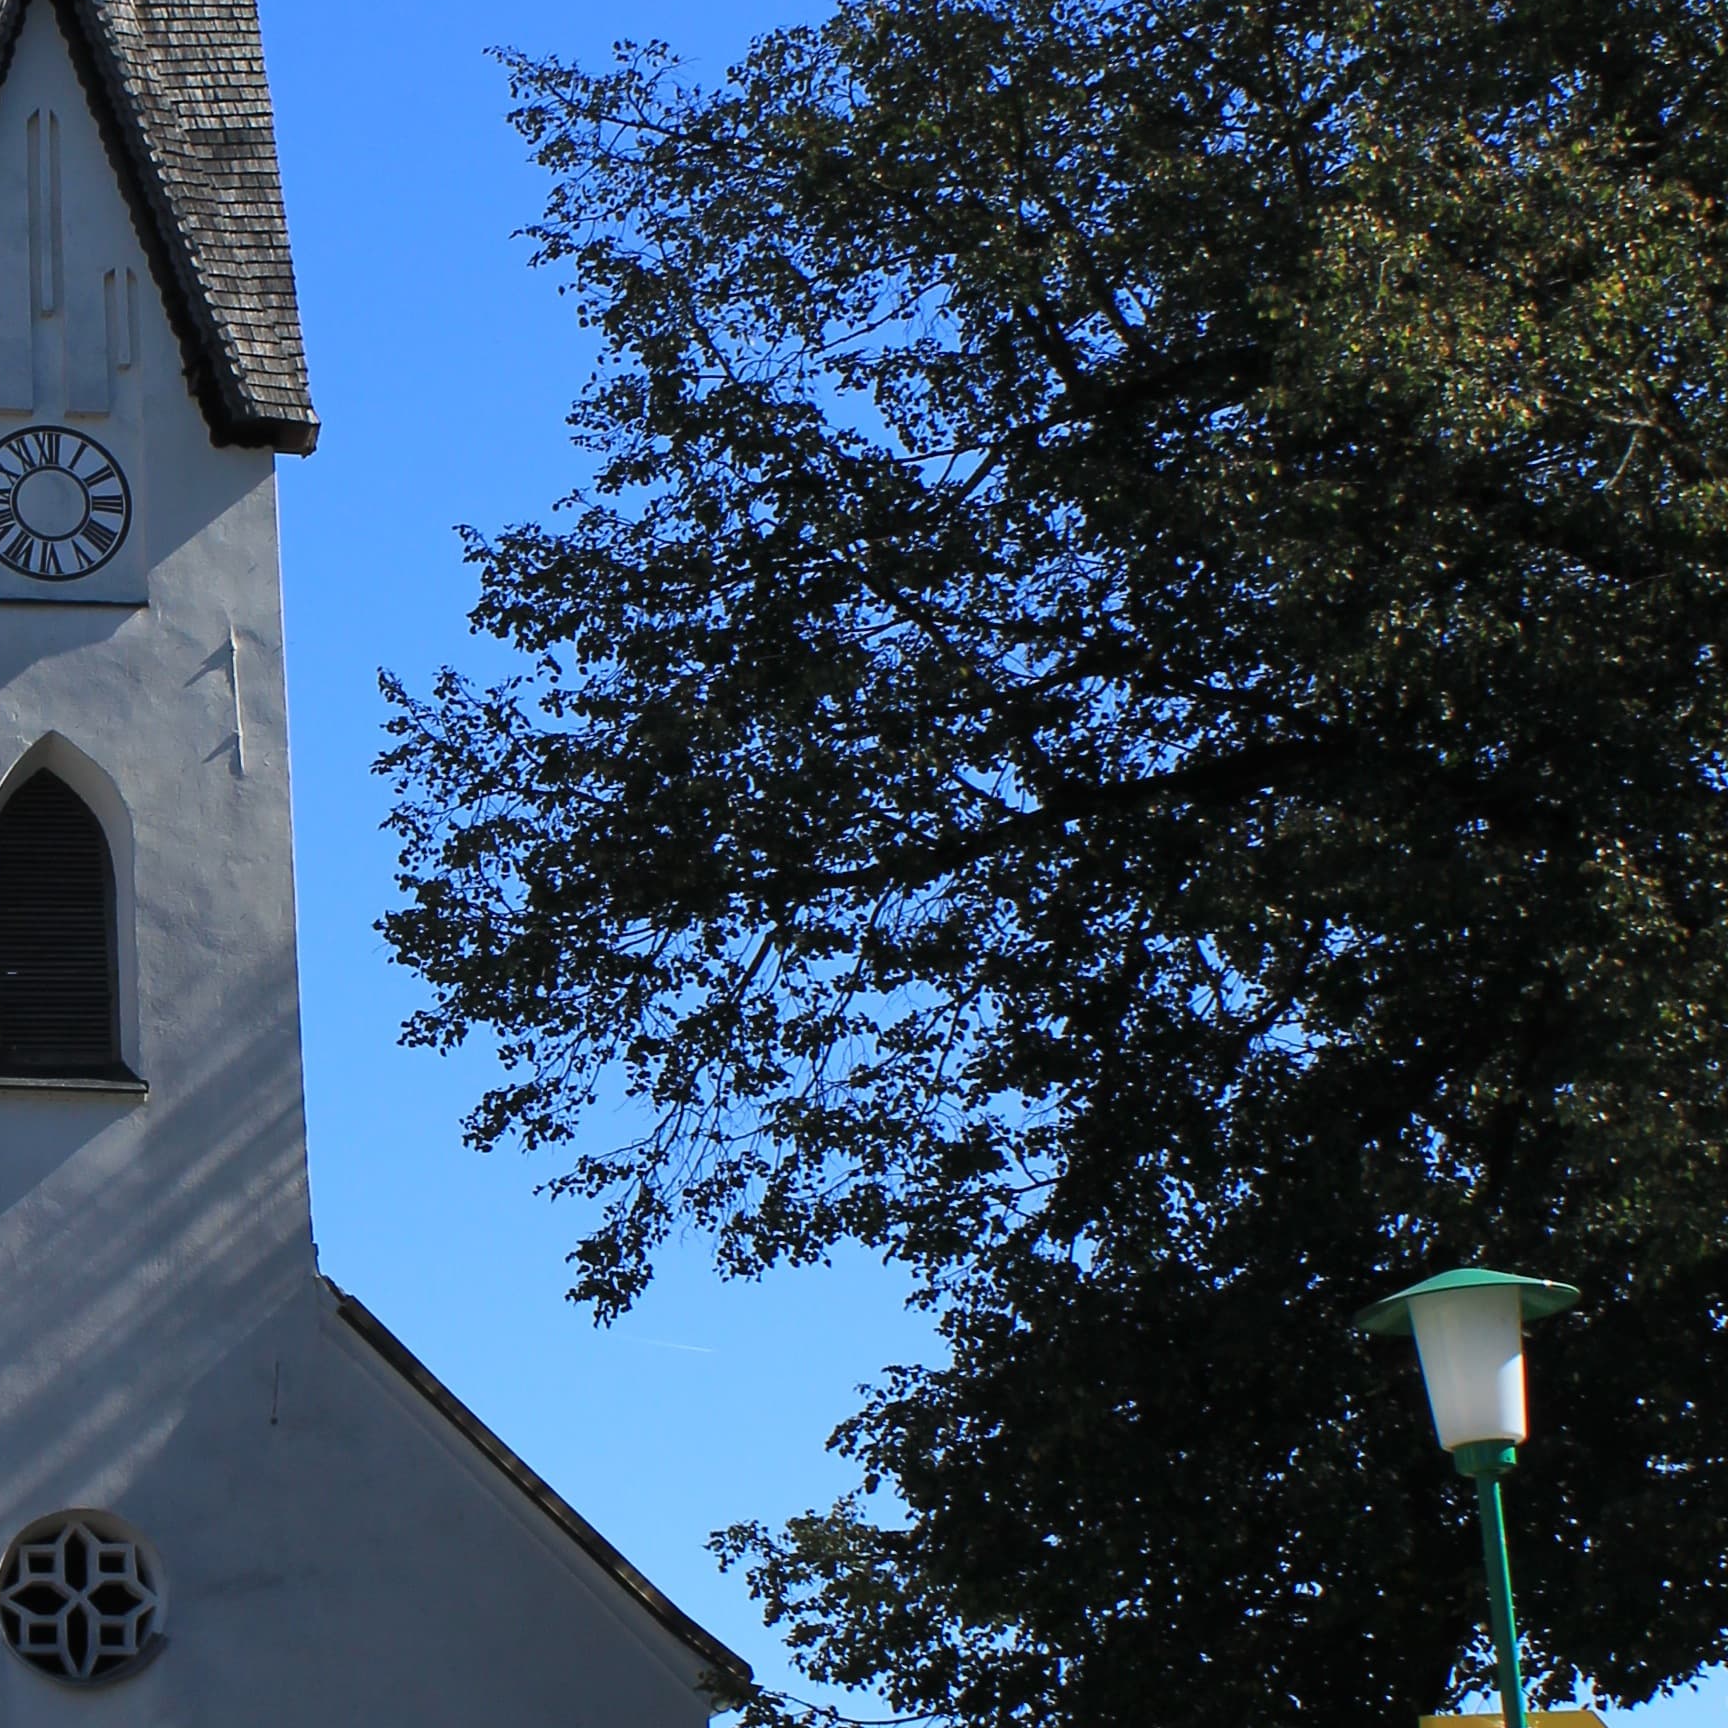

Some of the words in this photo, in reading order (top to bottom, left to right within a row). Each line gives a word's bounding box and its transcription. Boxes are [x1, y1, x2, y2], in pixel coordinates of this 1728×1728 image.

[6, 437, 37, 471] XI
[32, 432, 61, 465] XII
[68, 441, 88, 470] I
[82, 464, 115, 487] II
[91, 494, 123, 514] III
[3, 532, 34, 570] VII
[80, 517, 118, 554] IIII
[40, 541, 64, 574] VI
[72, 540, 95, 570] V
